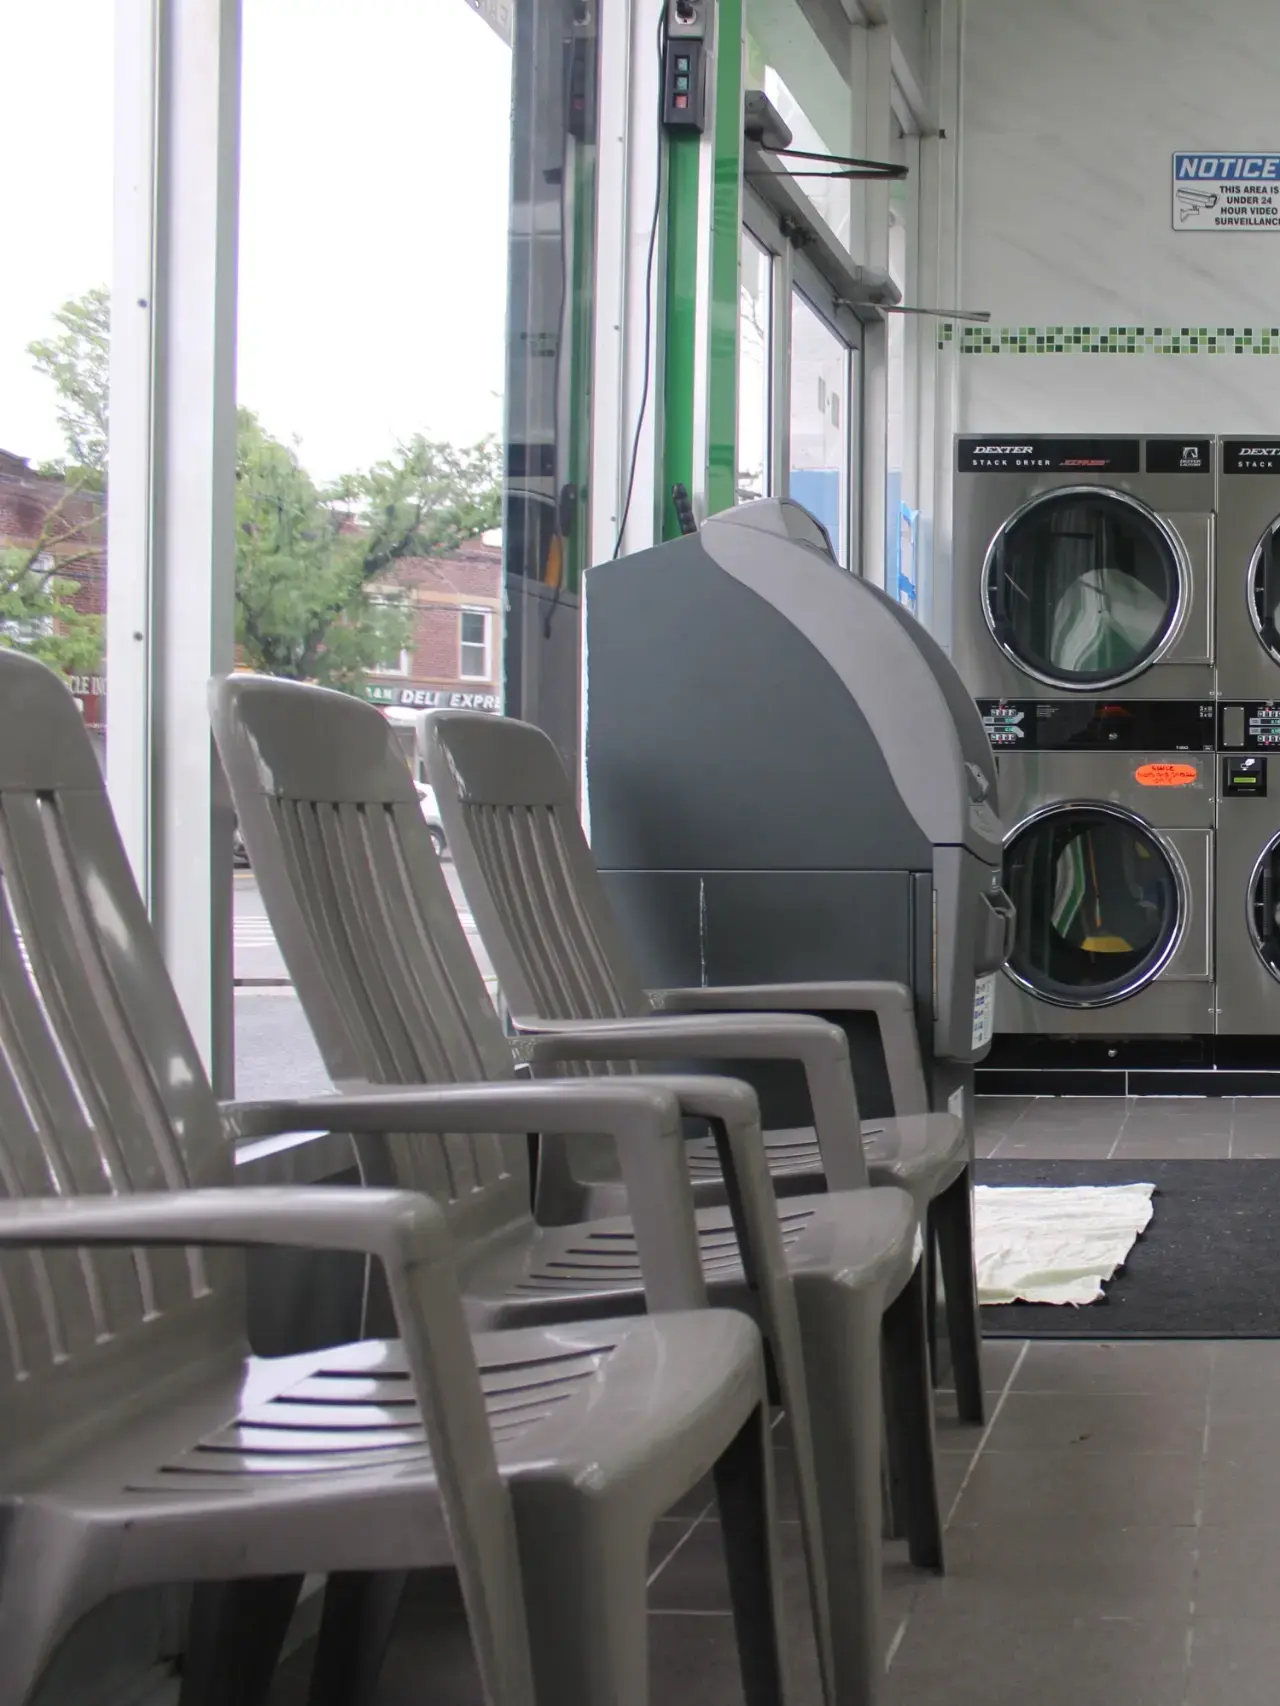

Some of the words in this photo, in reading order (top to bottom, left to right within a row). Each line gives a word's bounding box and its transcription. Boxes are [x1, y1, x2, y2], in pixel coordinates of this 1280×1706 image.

[1179, 158, 1280, 178] NOTICE
[1219, 185, 1240, 194] THIS
[1244, 185, 1267, 194] AREA
[1270, 186, 1279, 194] IS
[1226, 196, 1258, 204] UNDER
[1261, 196, 1272, 204] 24
[1221, 207, 1247, 215] HOUR
[1250, 207, 1278, 215] VIDEO
[973, 446, 1033, 454] DEXTER
[401, 688, 439, 705] DELI
